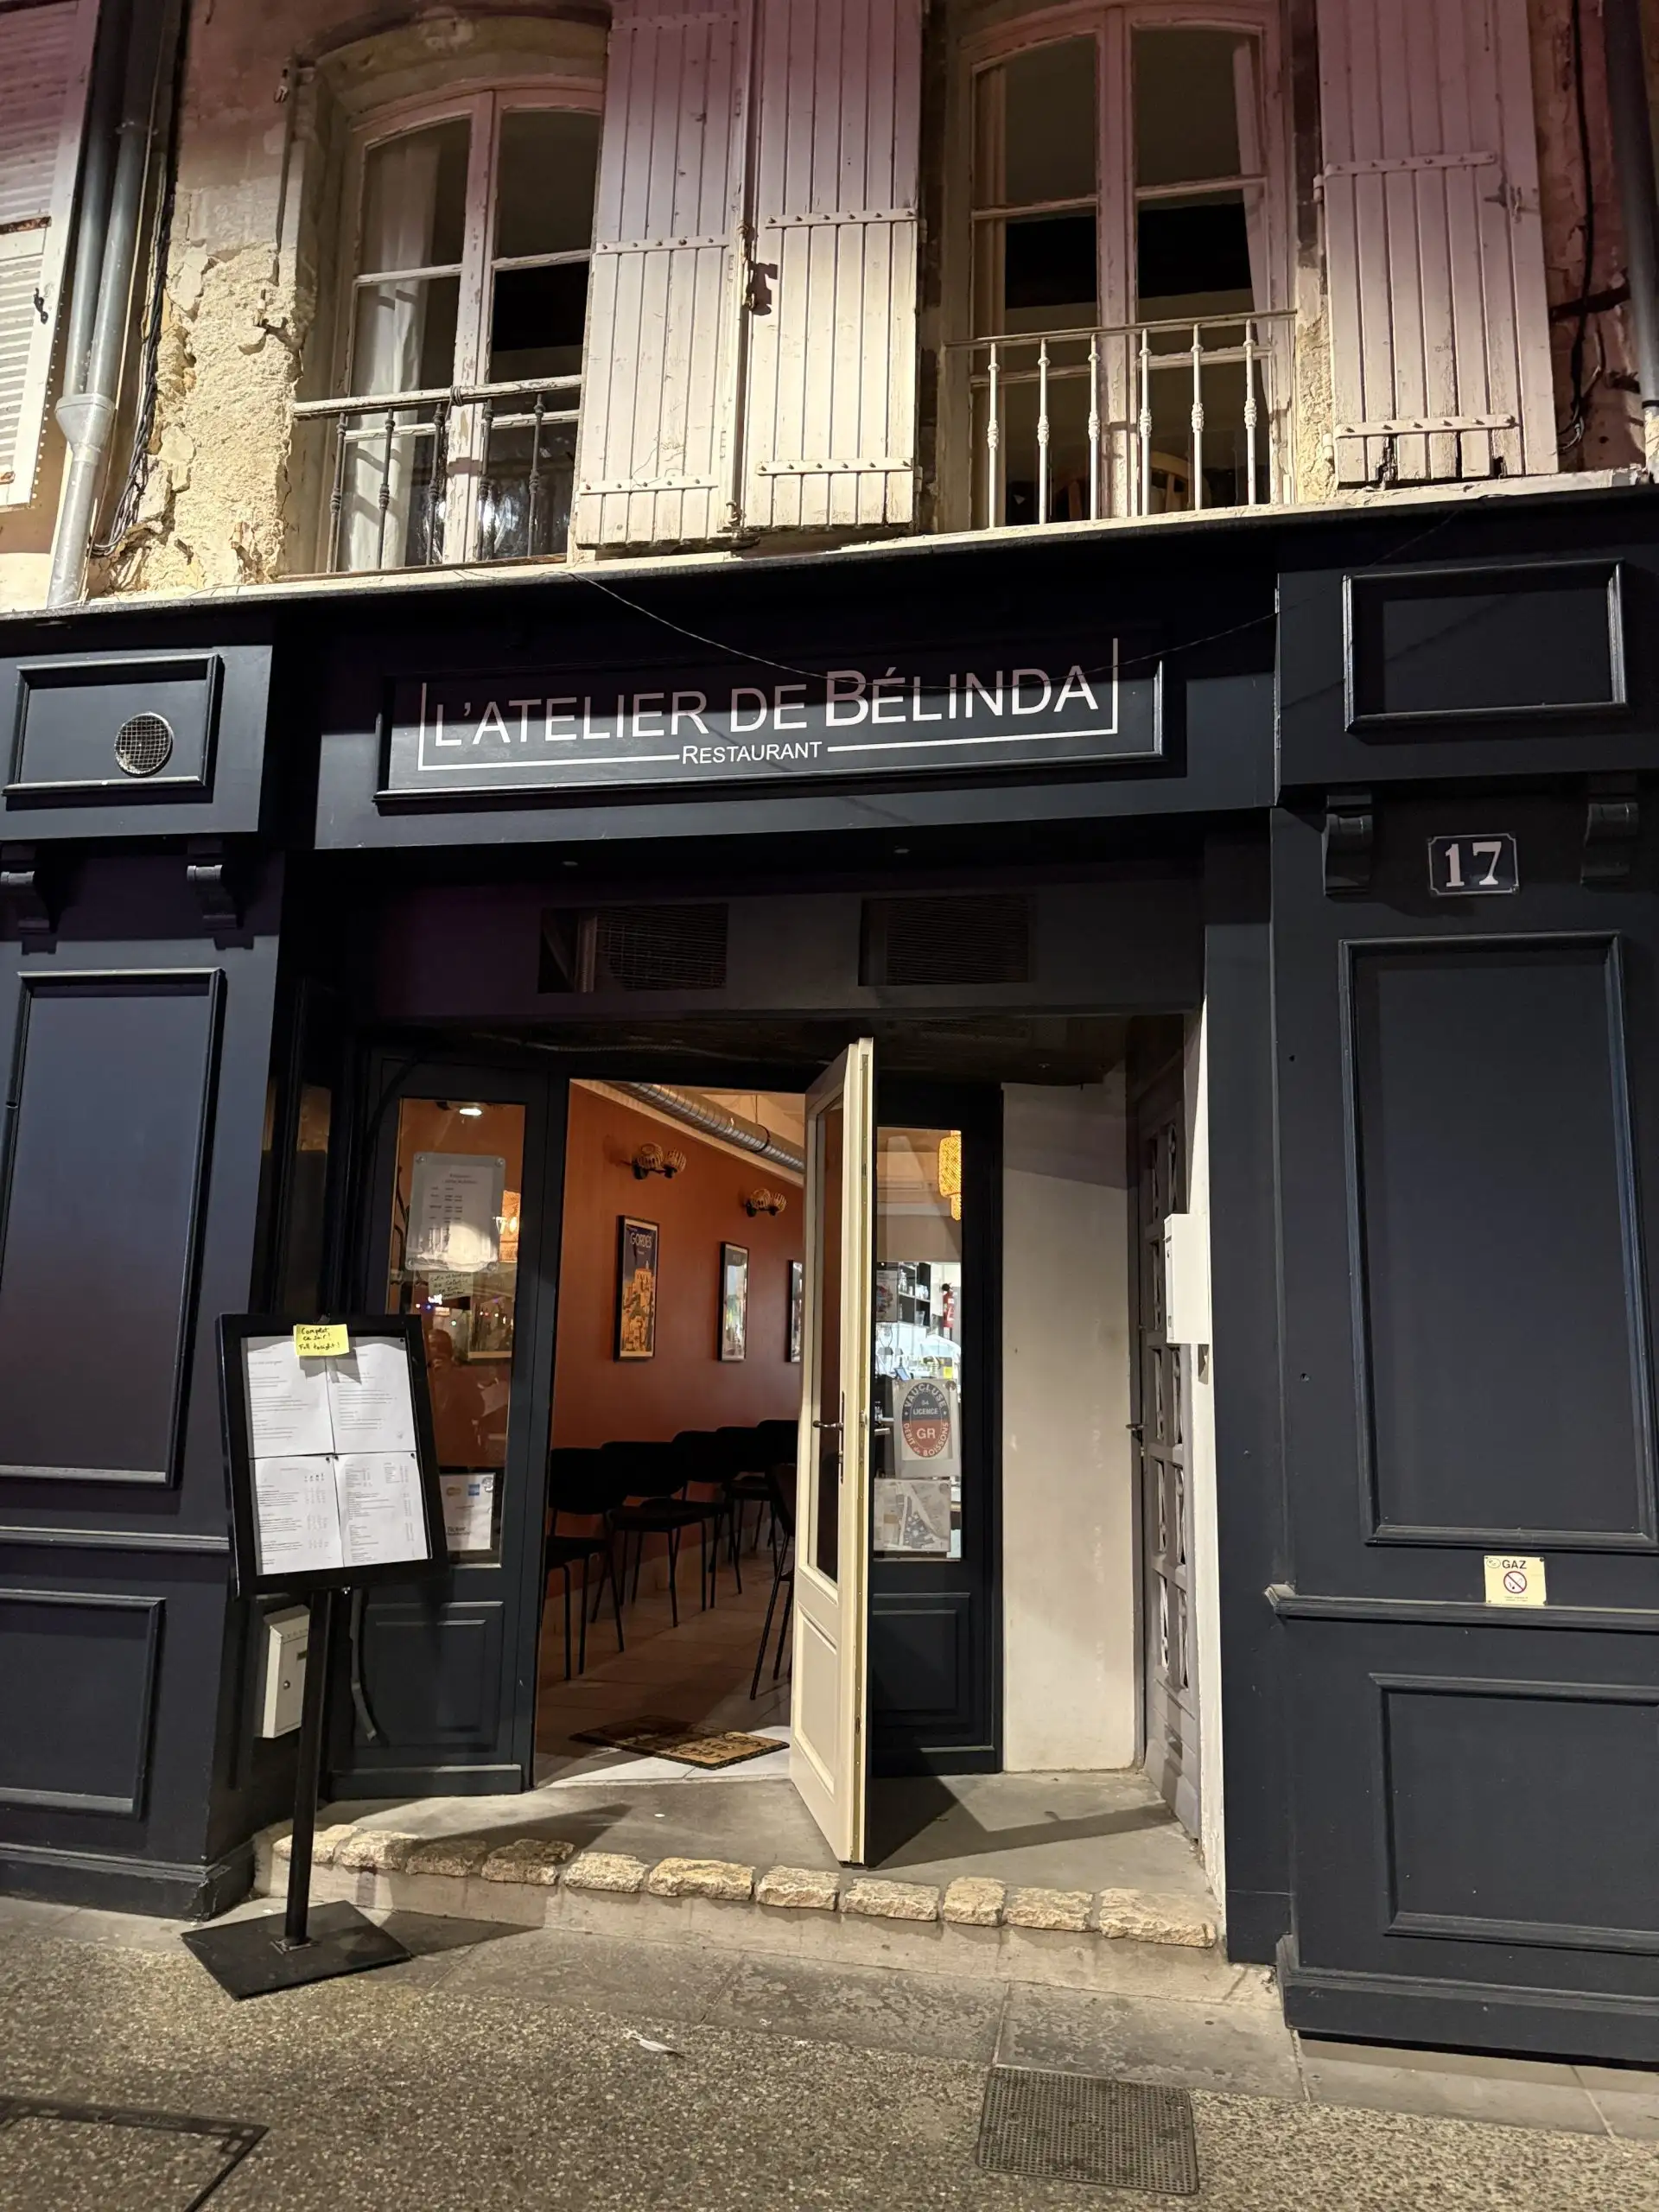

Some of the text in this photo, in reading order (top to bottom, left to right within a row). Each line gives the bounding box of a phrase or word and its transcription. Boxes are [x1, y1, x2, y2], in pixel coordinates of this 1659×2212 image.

[435, 664, 1099, 747] L'ATELIER DE BÉLINDA
[681, 741, 823, 765] RESTAURANT
[1445, 841, 1502, 887] 17
[905, 1382, 947, 1408] VAUCLUSE
[916, 1427, 937, 1440] GR
[923, 1422, 949, 1457] BOISSONS
[1502, 1559, 1528, 1570] GAZ
